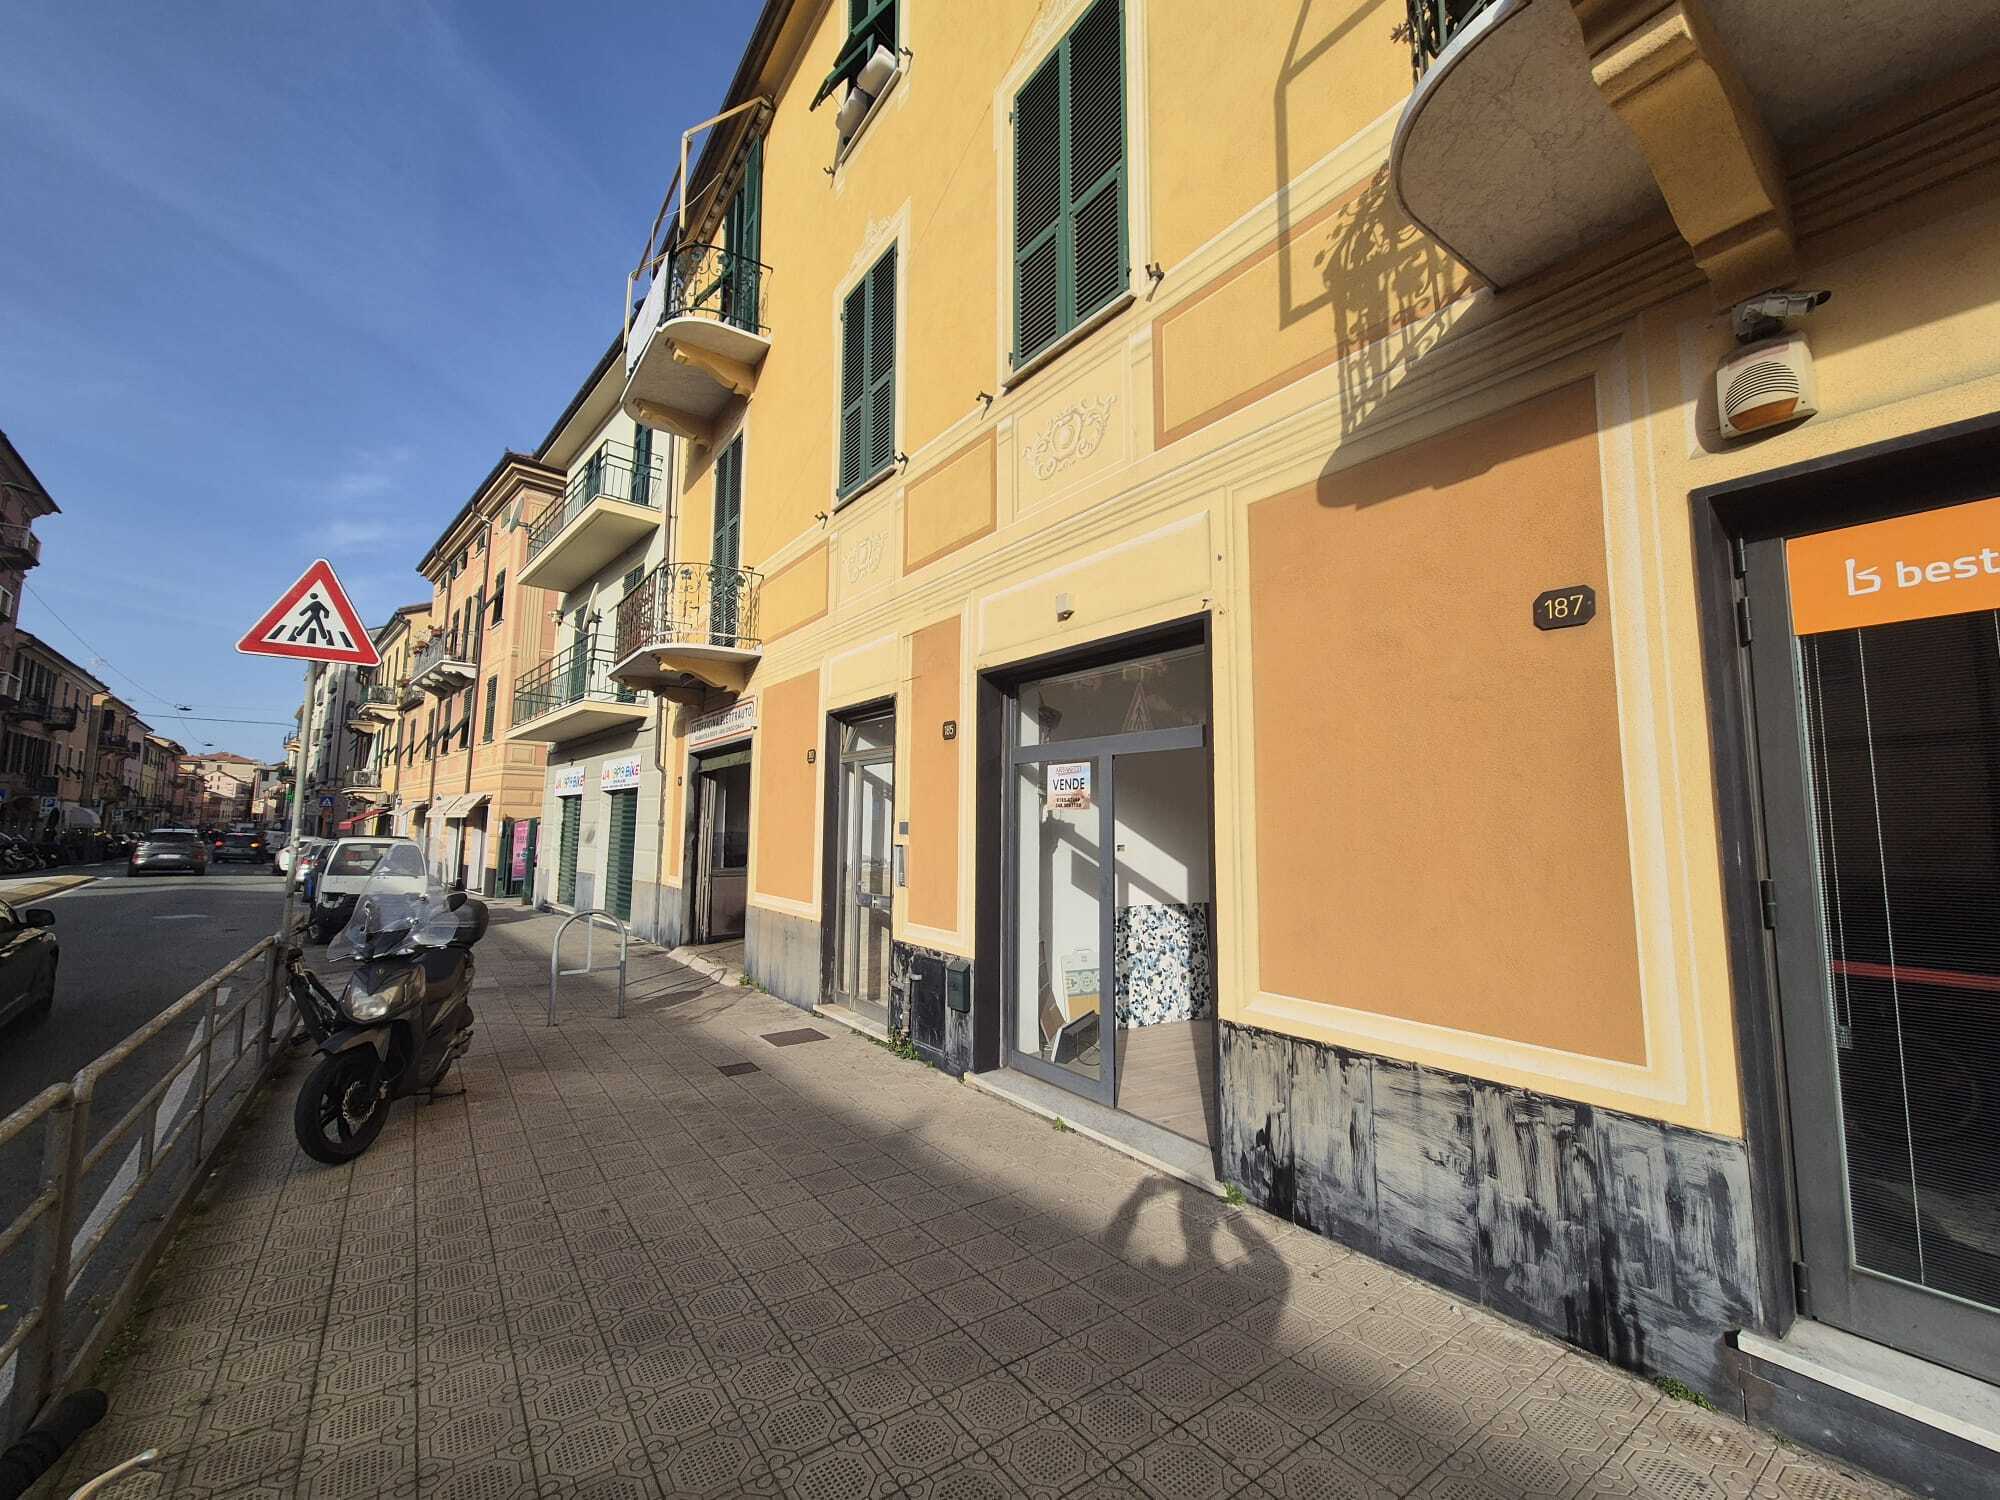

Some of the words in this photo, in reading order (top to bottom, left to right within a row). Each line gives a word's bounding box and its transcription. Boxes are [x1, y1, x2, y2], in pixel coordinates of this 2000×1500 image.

[1896, 548, 2000, 588] best
[1544, 594, 1584, 619] 187
[944, 724, 954, 736] 185
[1052, 777, 1085, 791] VENDE
